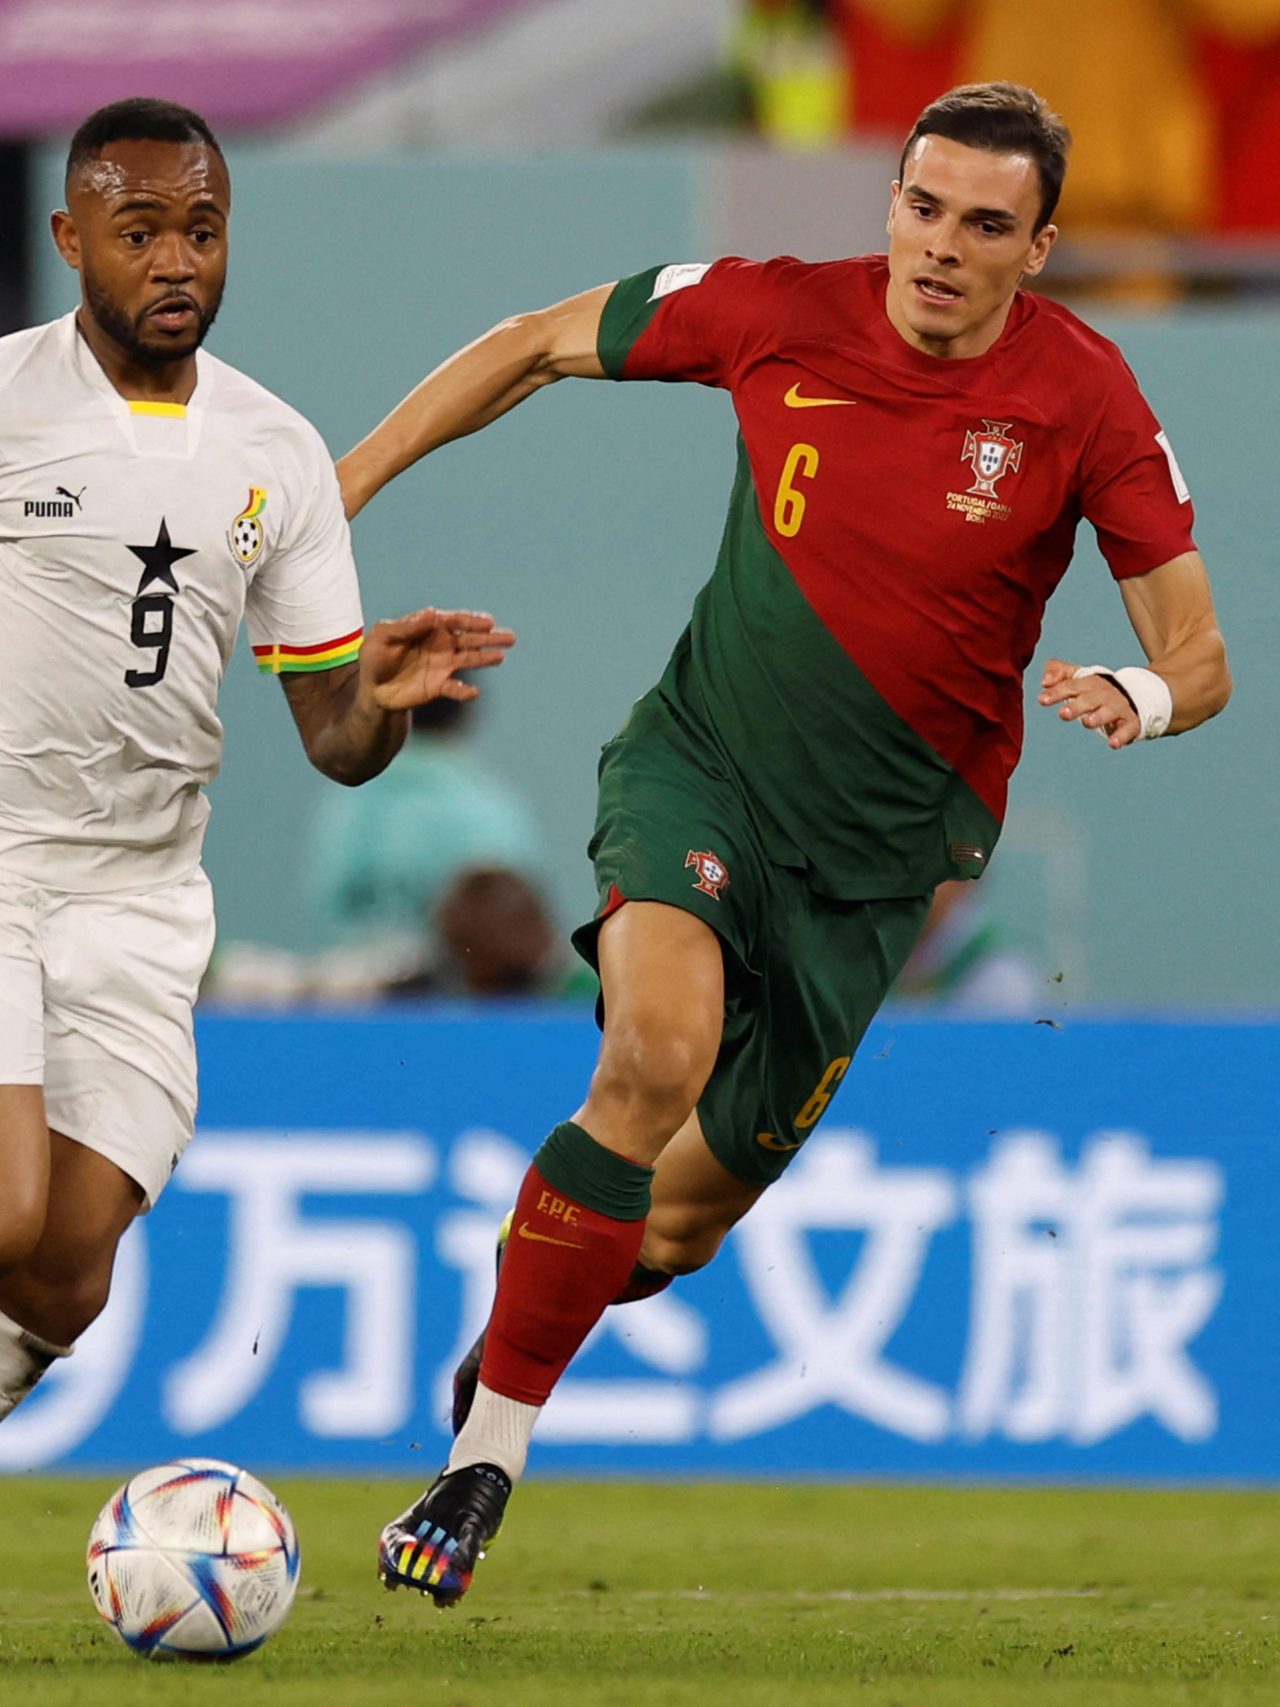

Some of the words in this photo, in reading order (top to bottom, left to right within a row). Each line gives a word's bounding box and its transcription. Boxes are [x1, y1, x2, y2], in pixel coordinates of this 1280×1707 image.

[24, 501, 73, 517] PUMA
[774, 443, 819, 537] 6
[946, 500, 956, 510] 24
[124, 594, 174, 688] 9
[794, 1056, 851, 1128] 6
